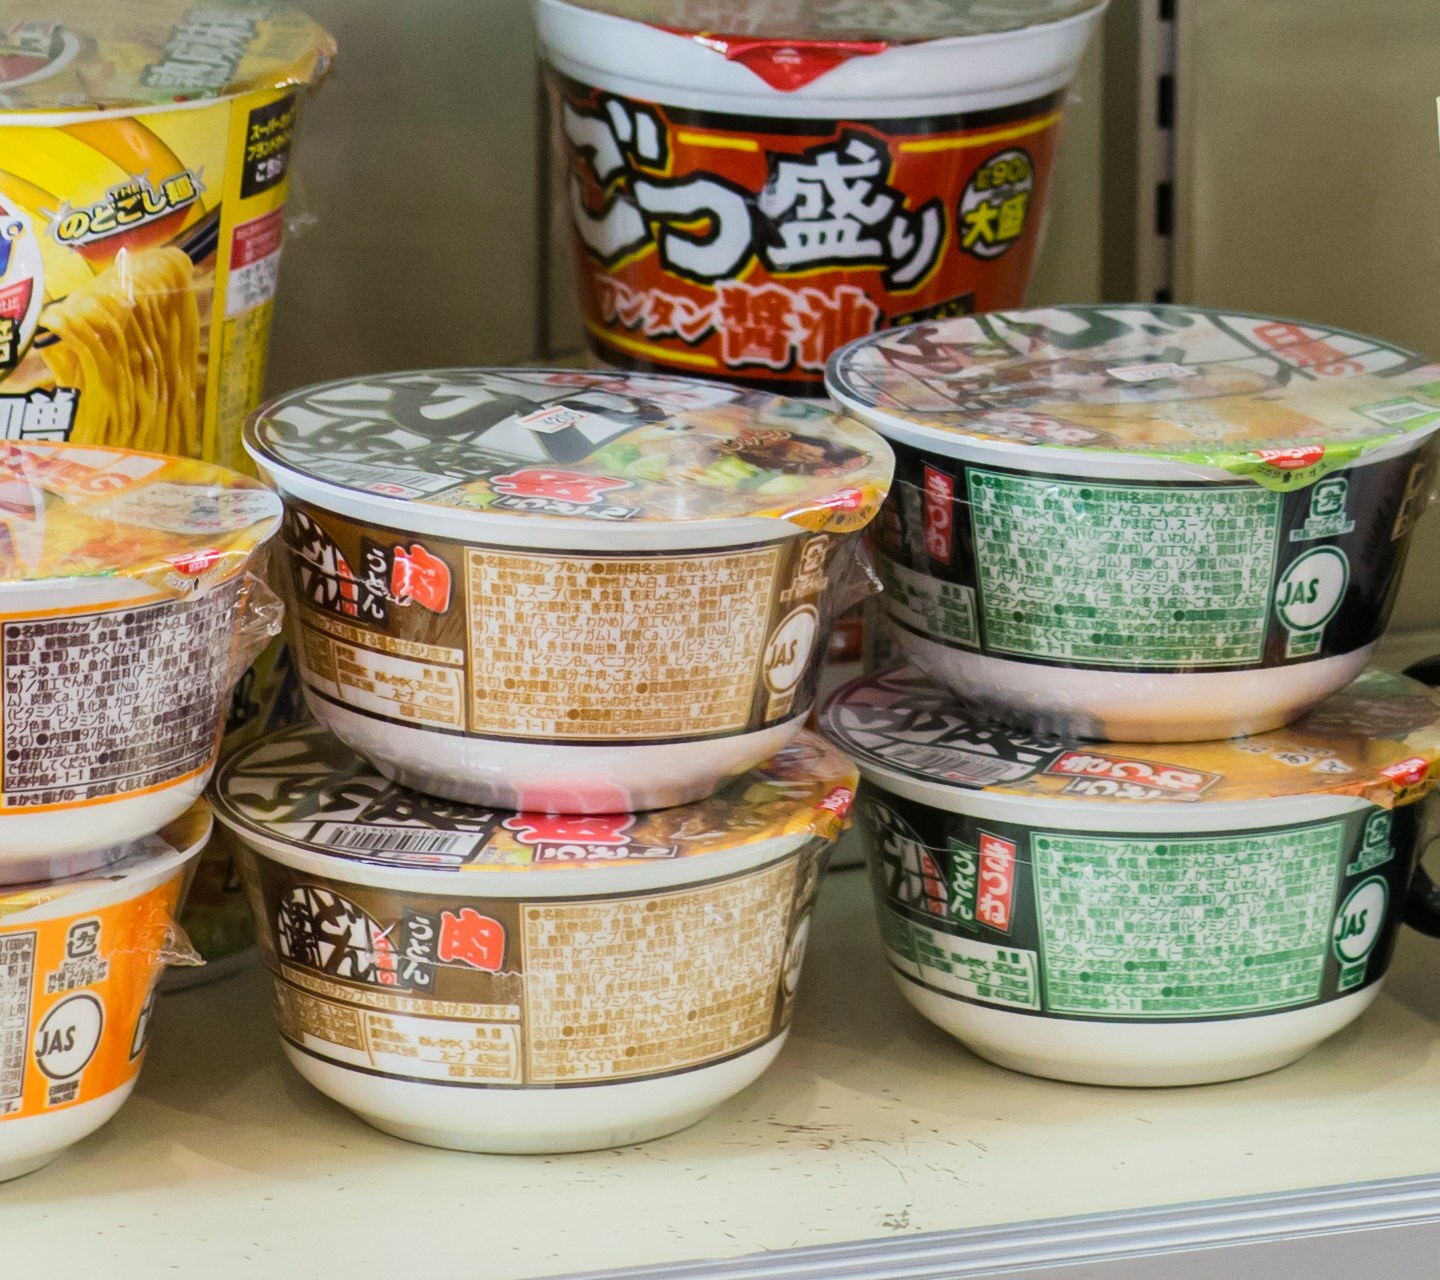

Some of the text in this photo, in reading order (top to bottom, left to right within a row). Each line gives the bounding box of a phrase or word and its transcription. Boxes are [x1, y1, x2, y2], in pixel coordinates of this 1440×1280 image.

[1277, 580, 1321, 609] JAS
[763, 639, 799, 677] JAS
[978, 840, 1014, 927] きつね
[1334, 909, 1369, 944] JAS
[34, 1026, 76, 1060] JAS
